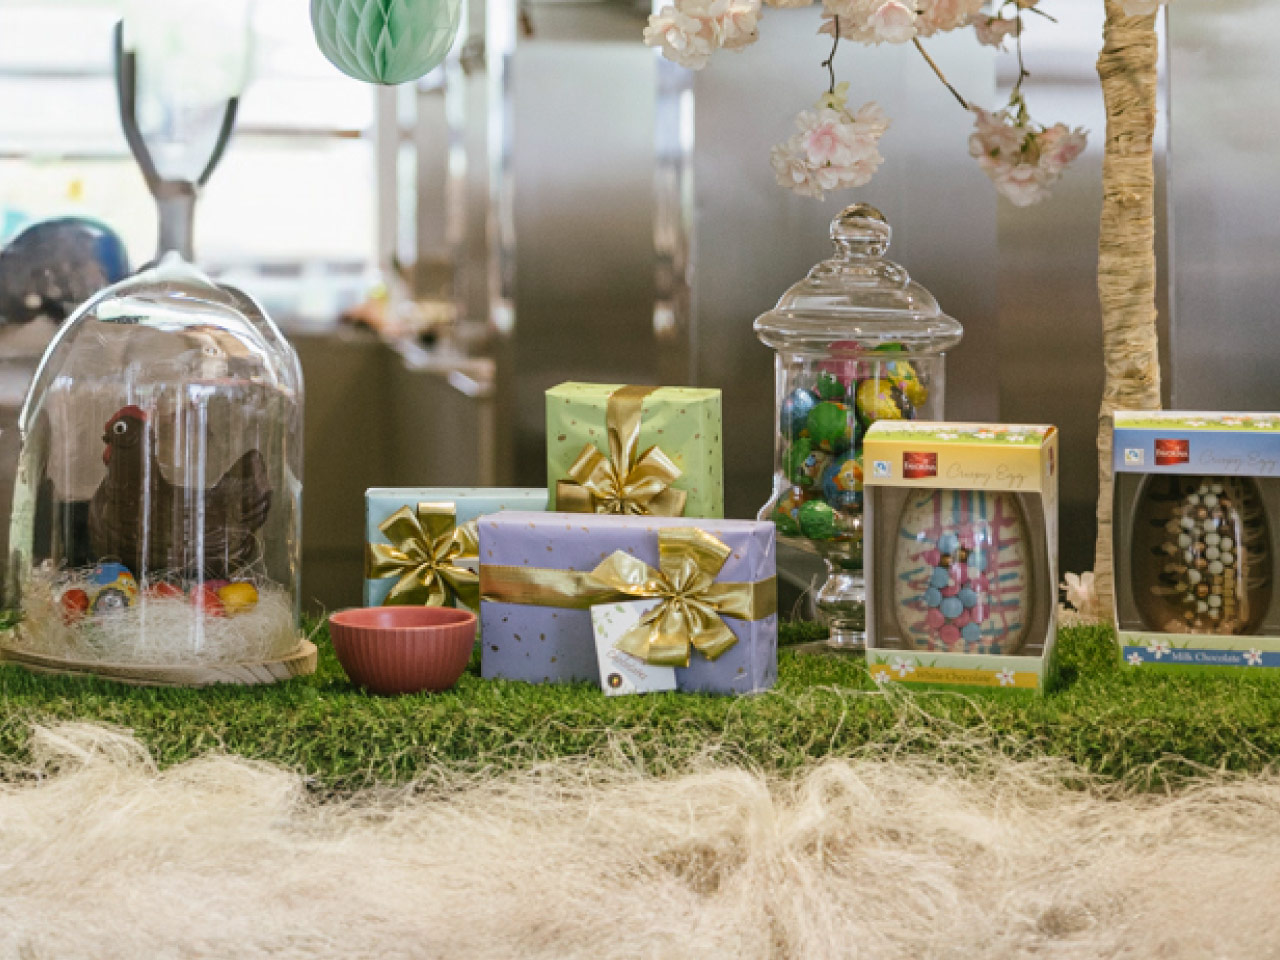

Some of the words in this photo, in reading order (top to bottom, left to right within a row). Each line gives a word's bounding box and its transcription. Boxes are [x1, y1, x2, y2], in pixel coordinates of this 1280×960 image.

[995, 463, 1029, 488] Egg
[1173, 651, 1193, 661] Milk
[1195, 652, 1240, 663] Chocolate
